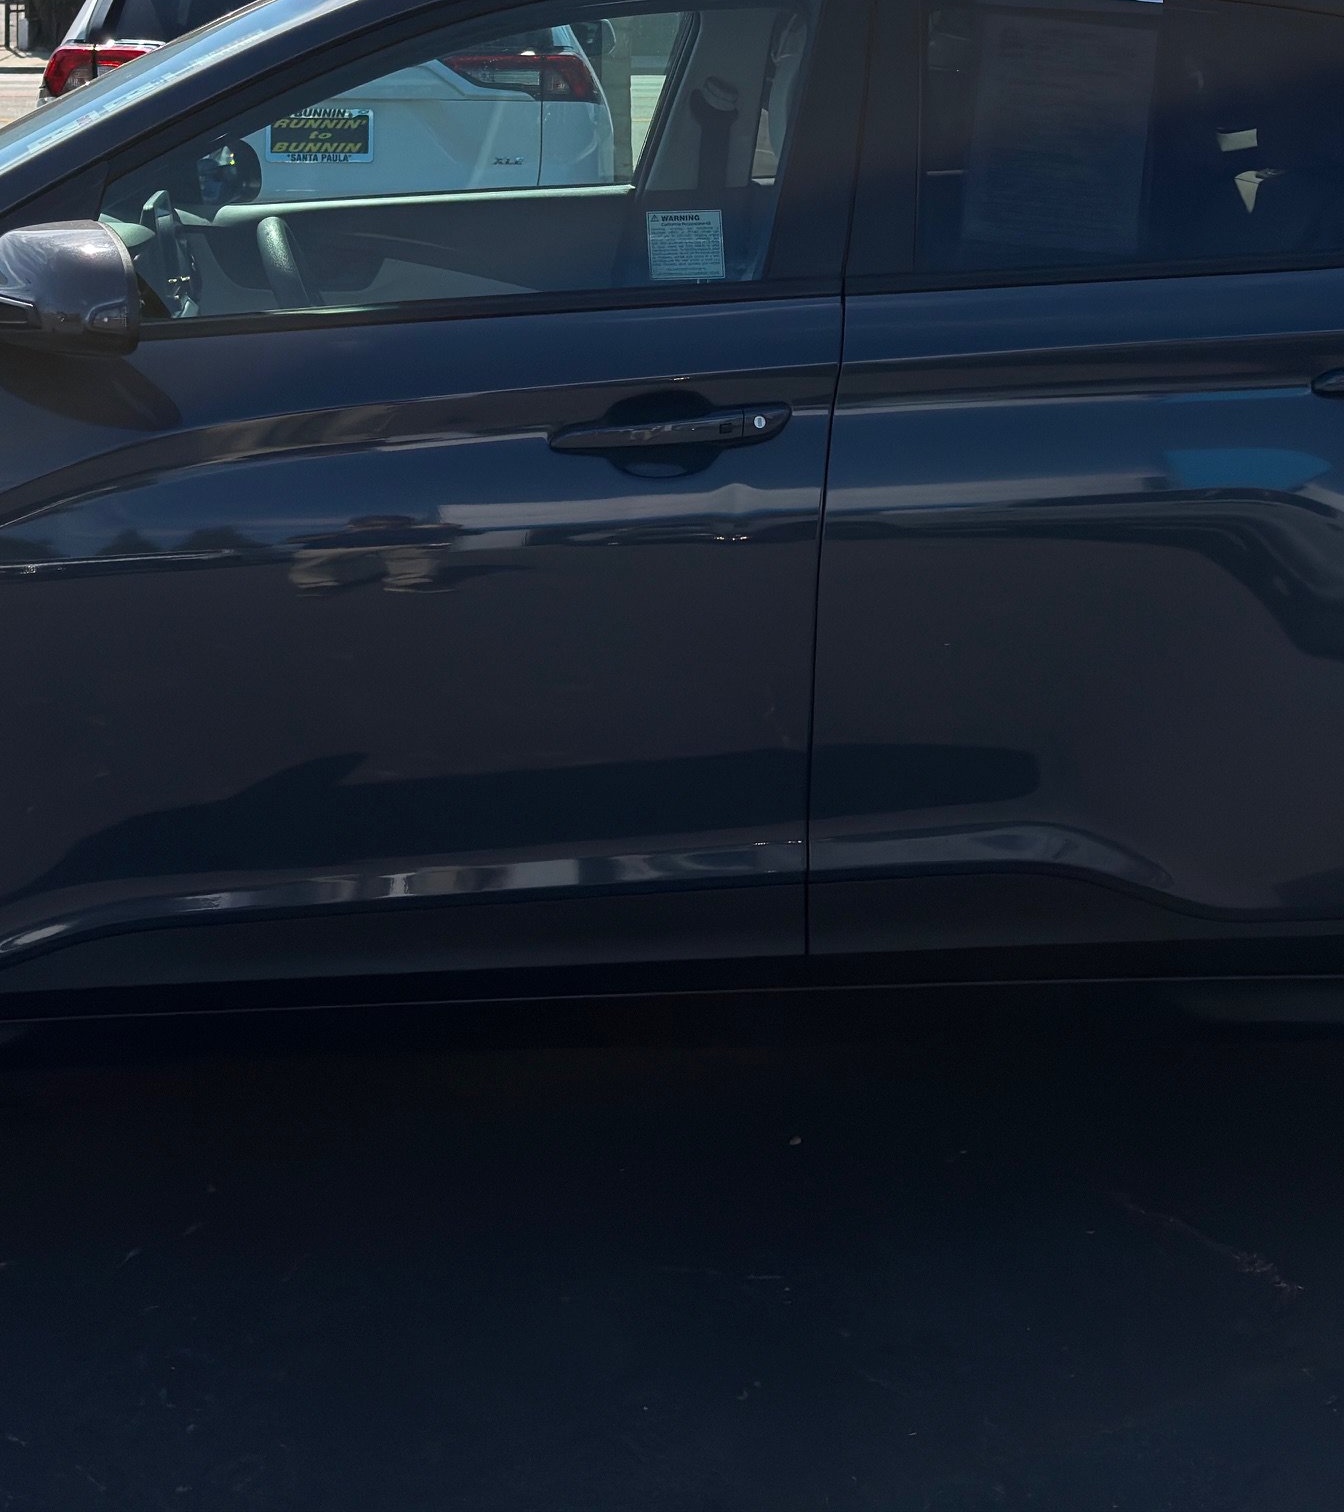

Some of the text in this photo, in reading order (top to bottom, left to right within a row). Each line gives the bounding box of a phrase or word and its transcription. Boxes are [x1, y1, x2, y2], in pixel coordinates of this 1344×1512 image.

[274, 118, 367, 129] RUNNIN'
[309, 129, 333, 139] to
[272, 142, 361, 153] BUNNIN
[661, 214, 700, 222] WARNING
